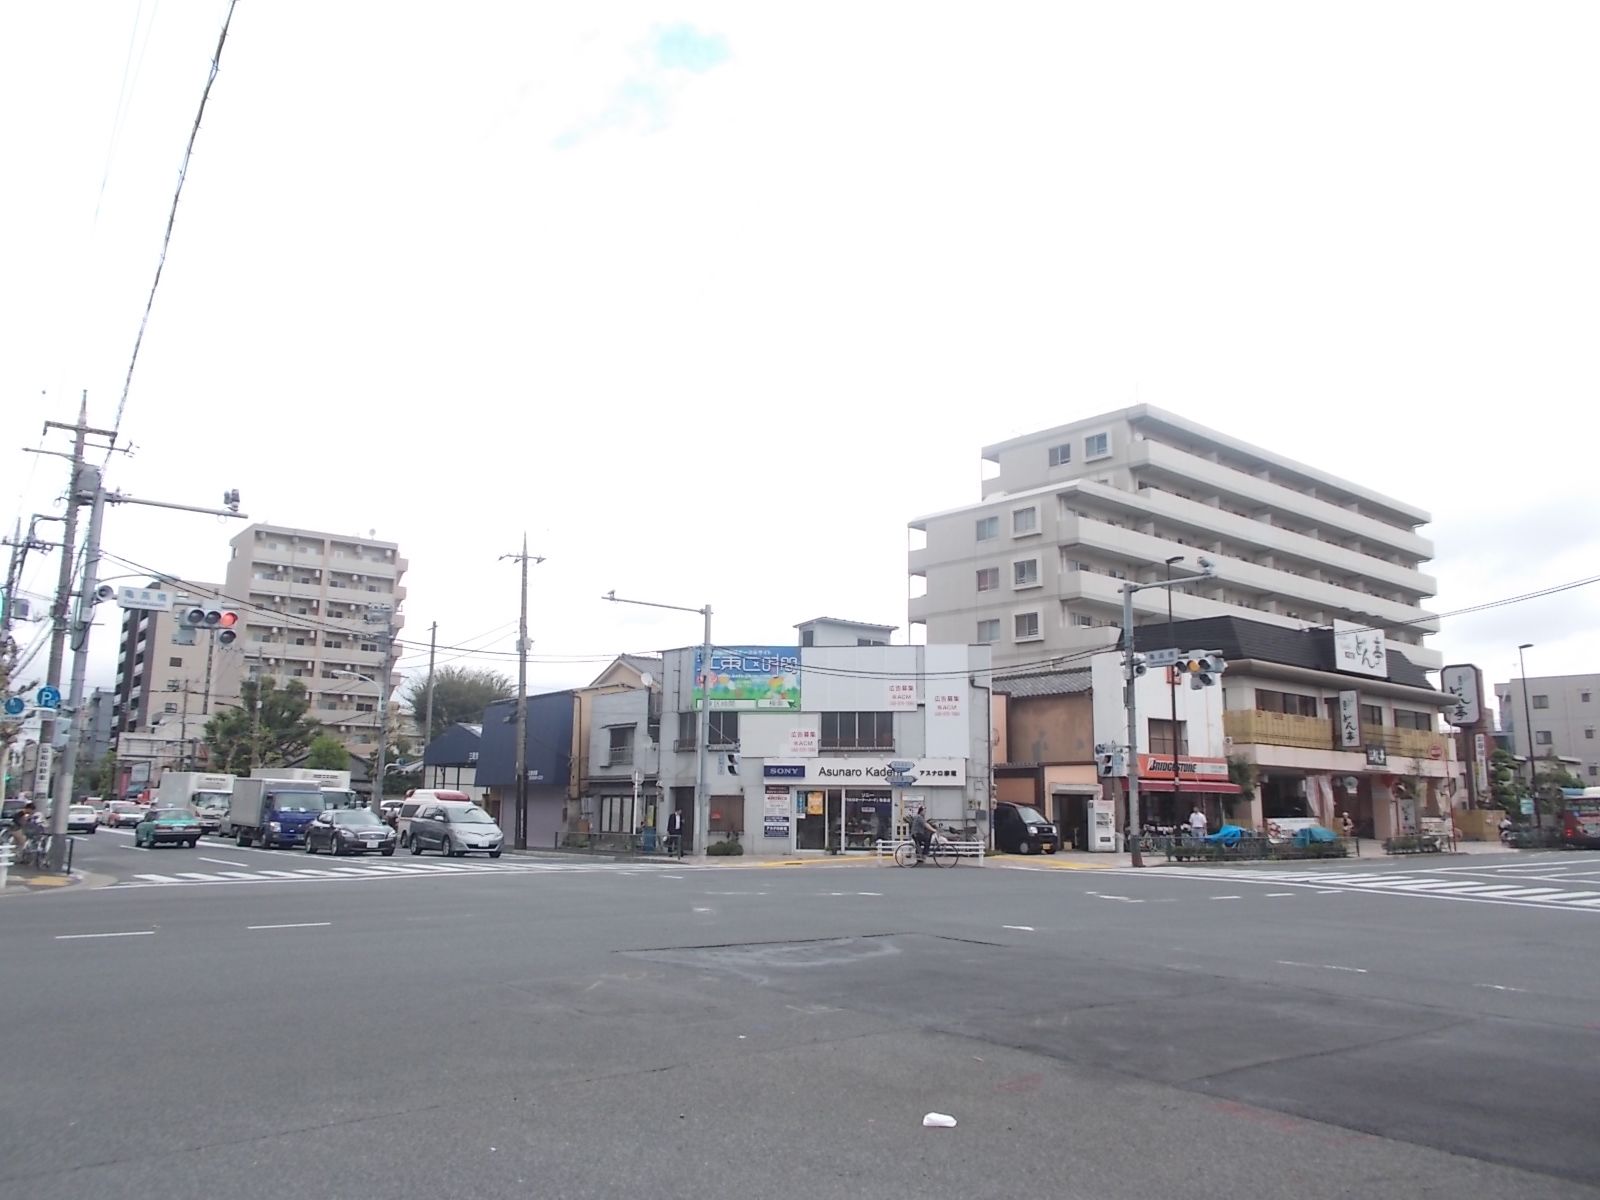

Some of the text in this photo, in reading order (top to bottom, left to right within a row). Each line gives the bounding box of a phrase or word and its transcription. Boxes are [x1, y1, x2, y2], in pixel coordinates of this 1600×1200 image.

[1149, 757, 1197, 773] BRIDGSTONE
[769, 767, 799, 776] SONY
[818, 766, 862, 777] Asunaro
